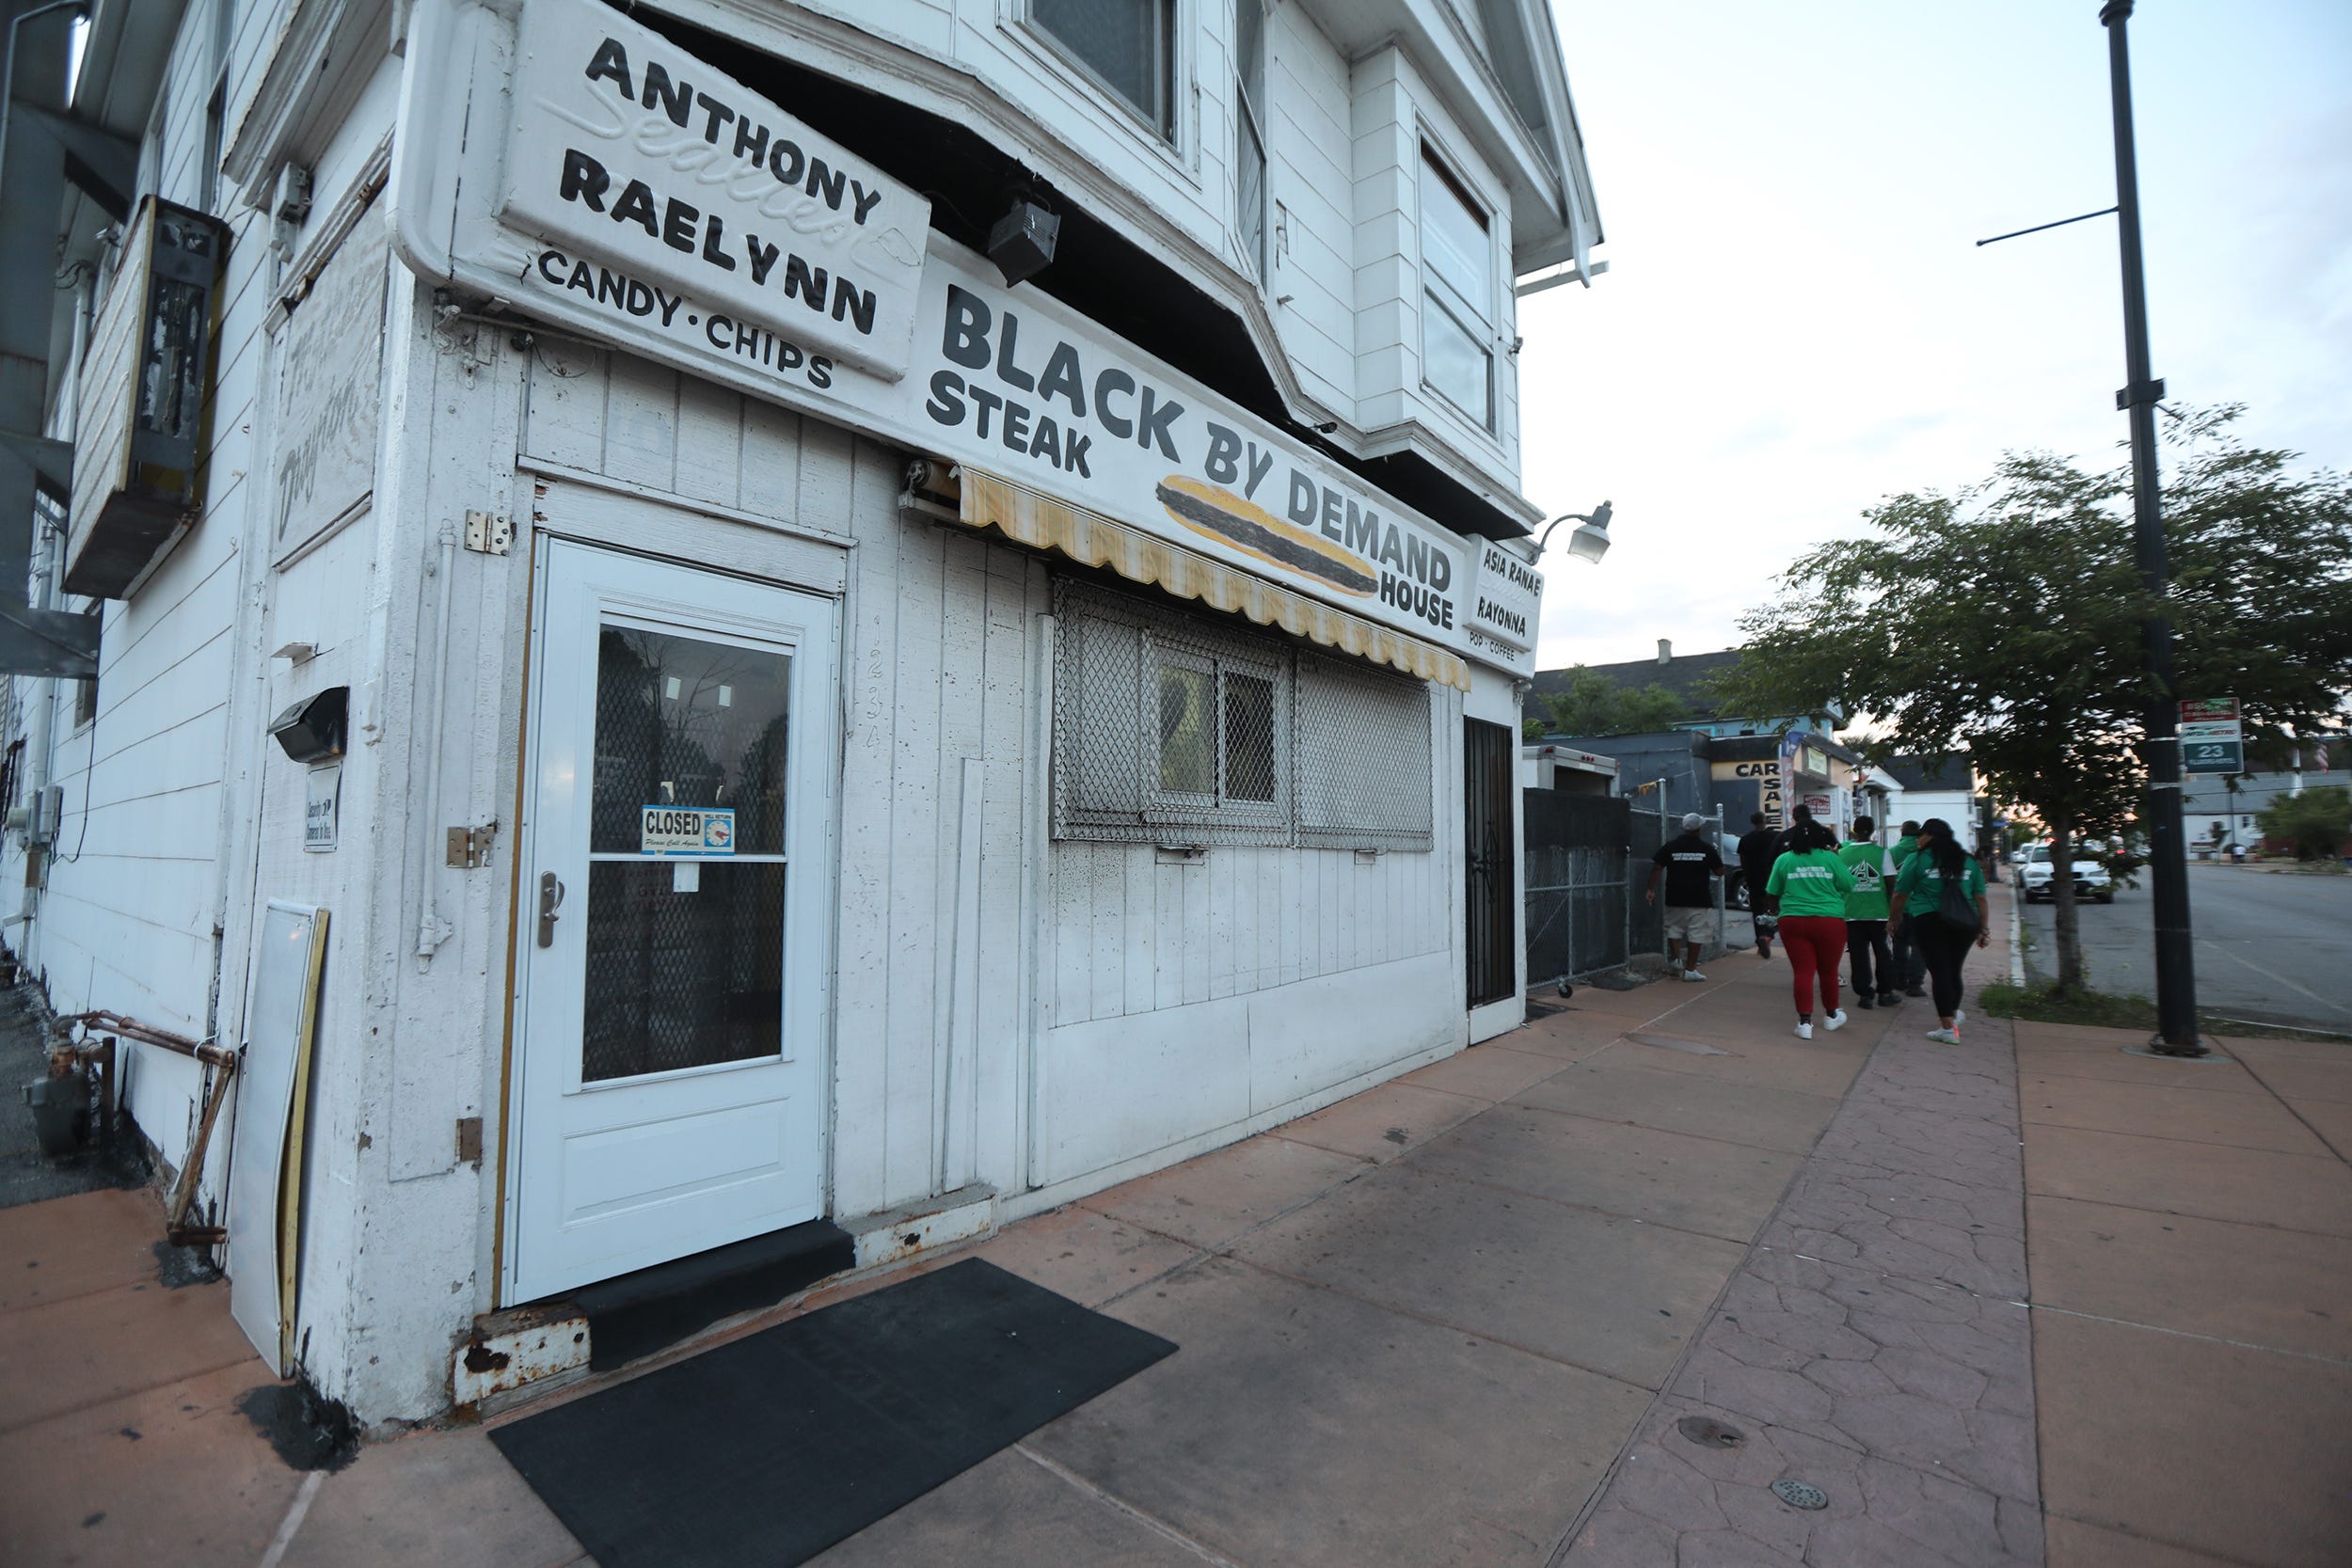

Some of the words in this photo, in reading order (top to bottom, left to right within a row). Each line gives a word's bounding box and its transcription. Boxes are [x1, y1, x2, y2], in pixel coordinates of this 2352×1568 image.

[585, 38, 881, 225] ANTHONY
[560, 149, 876, 335] RAELYNN
[538, 251, 682, 327] CANDY
[706, 315, 833, 388] CHIPS
[926, 370, 1091, 479] STEAK
[942, 284, 1184, 464] BLACK
[1203, 420, 1273, 500] BY
[1288, 467, 1452, 592] DEMAND
[1484, 548, 1505, 578] ASIA
[1509, 562, 1540, 596] RANAE
[1380, 570, 1454, 631] HOUSE
[1477, 596, 1526, 638] RAYONNA
[1470, 631, 1483, 648] POP
[1490, 641, 1514, 661] COFFEE
[1736, 763, 1780, 777] CAR
[2198, 745, 2224, 758] 23
[645, 811, 701, 835] CLOSED
